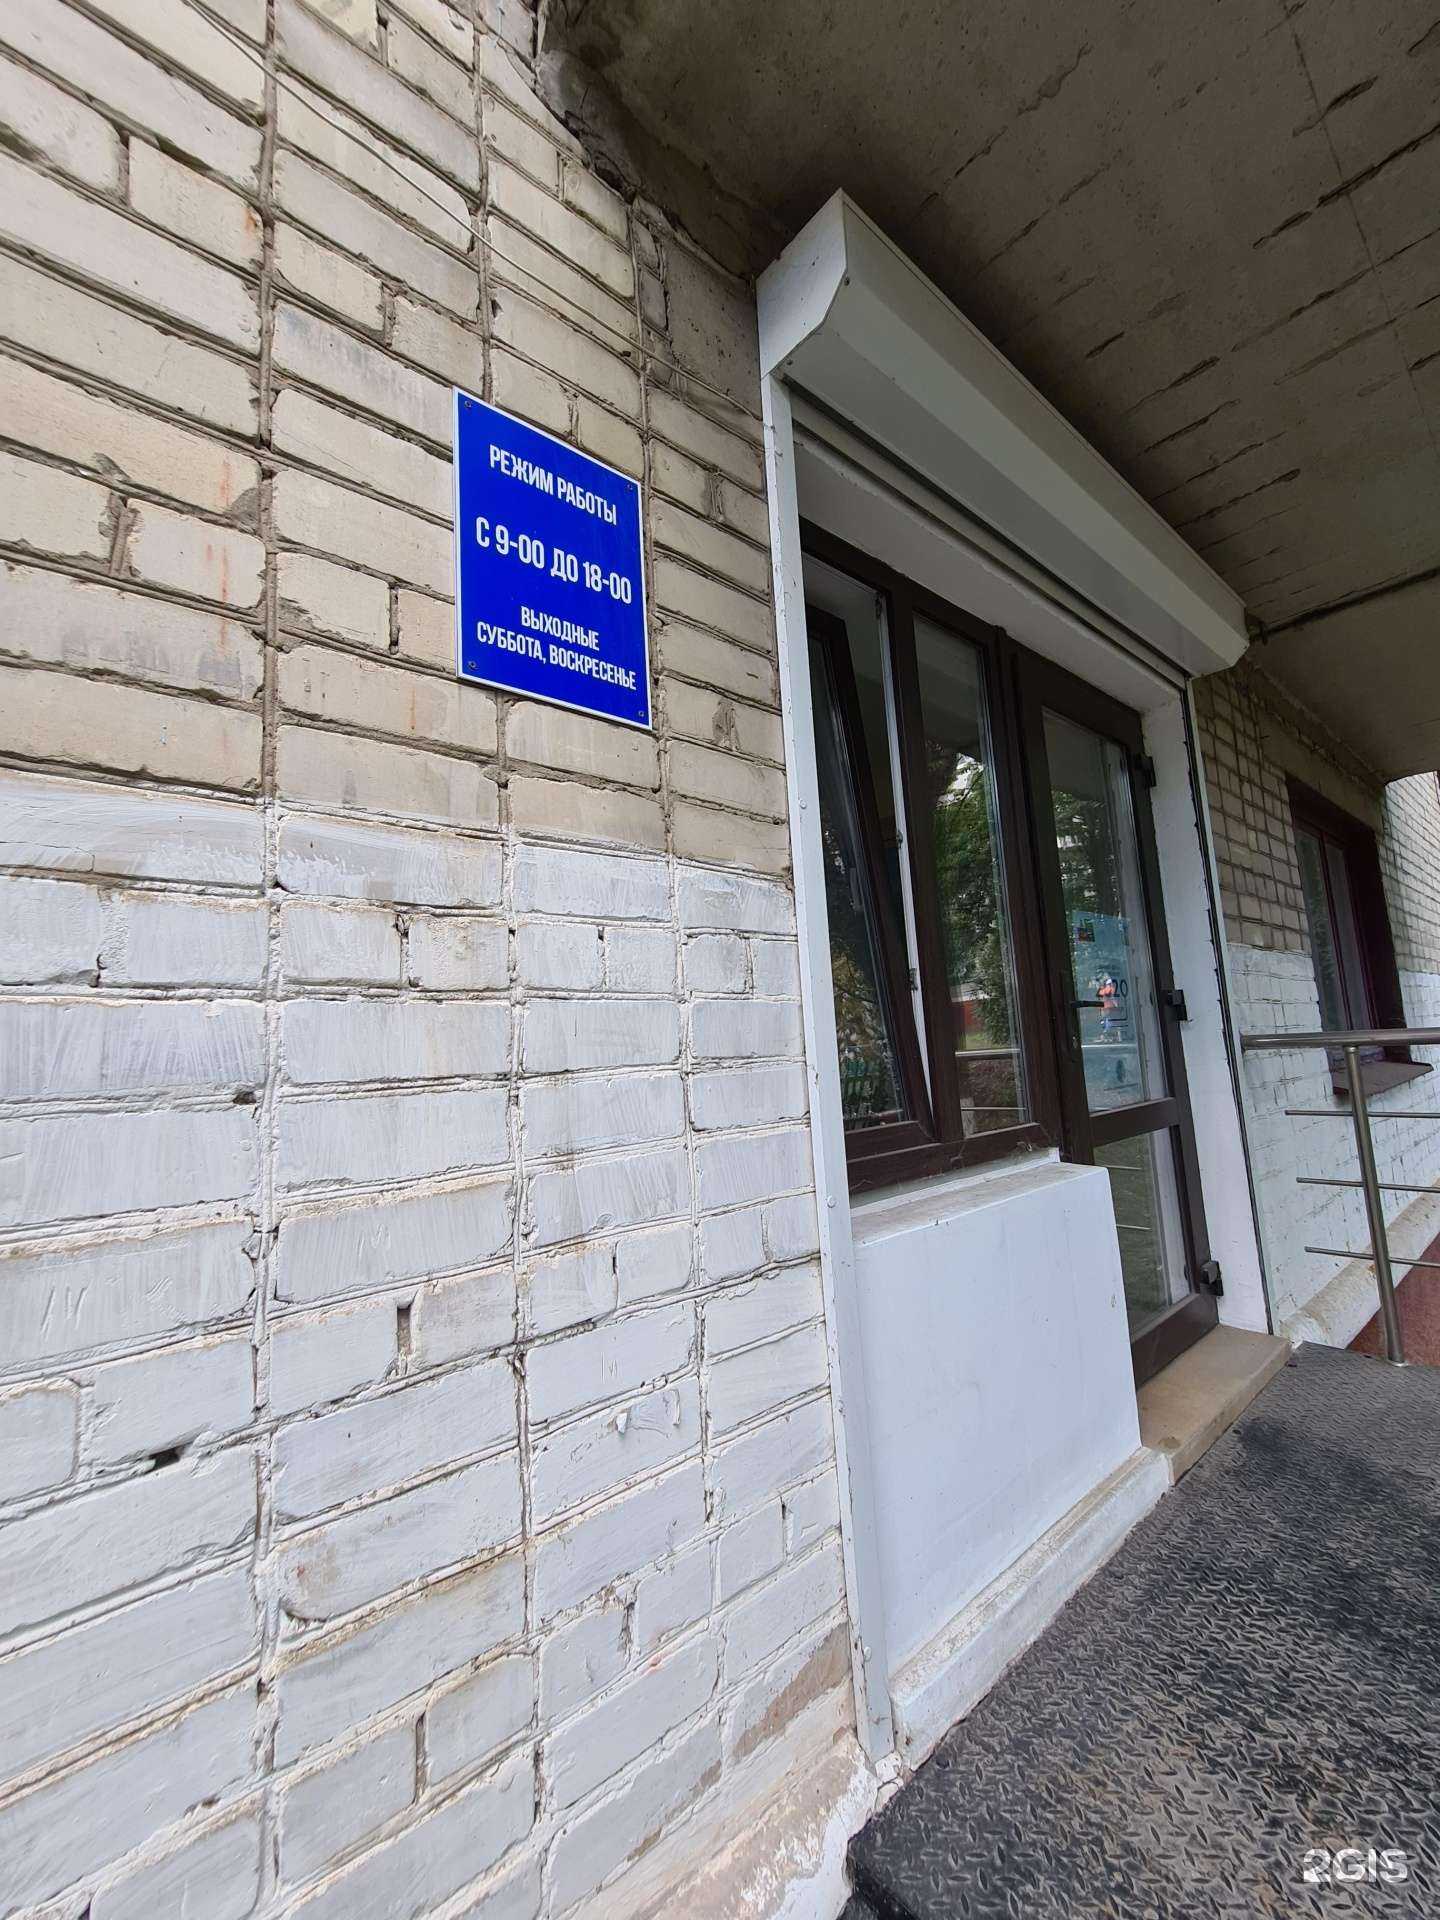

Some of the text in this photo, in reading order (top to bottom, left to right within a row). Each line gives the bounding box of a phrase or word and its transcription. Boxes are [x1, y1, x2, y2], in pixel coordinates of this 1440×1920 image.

[489, 444, 617, 526] РЕЖИМ РАБОТЫ
[475, 517, 632, 604] С 9-00 ДО 18-00
[477, 621, 637, 691] СУББОТА, ВОСКРЕСЕНЬЕ
[521, 605, 600, 652] ВЫХОДНЫЕ
